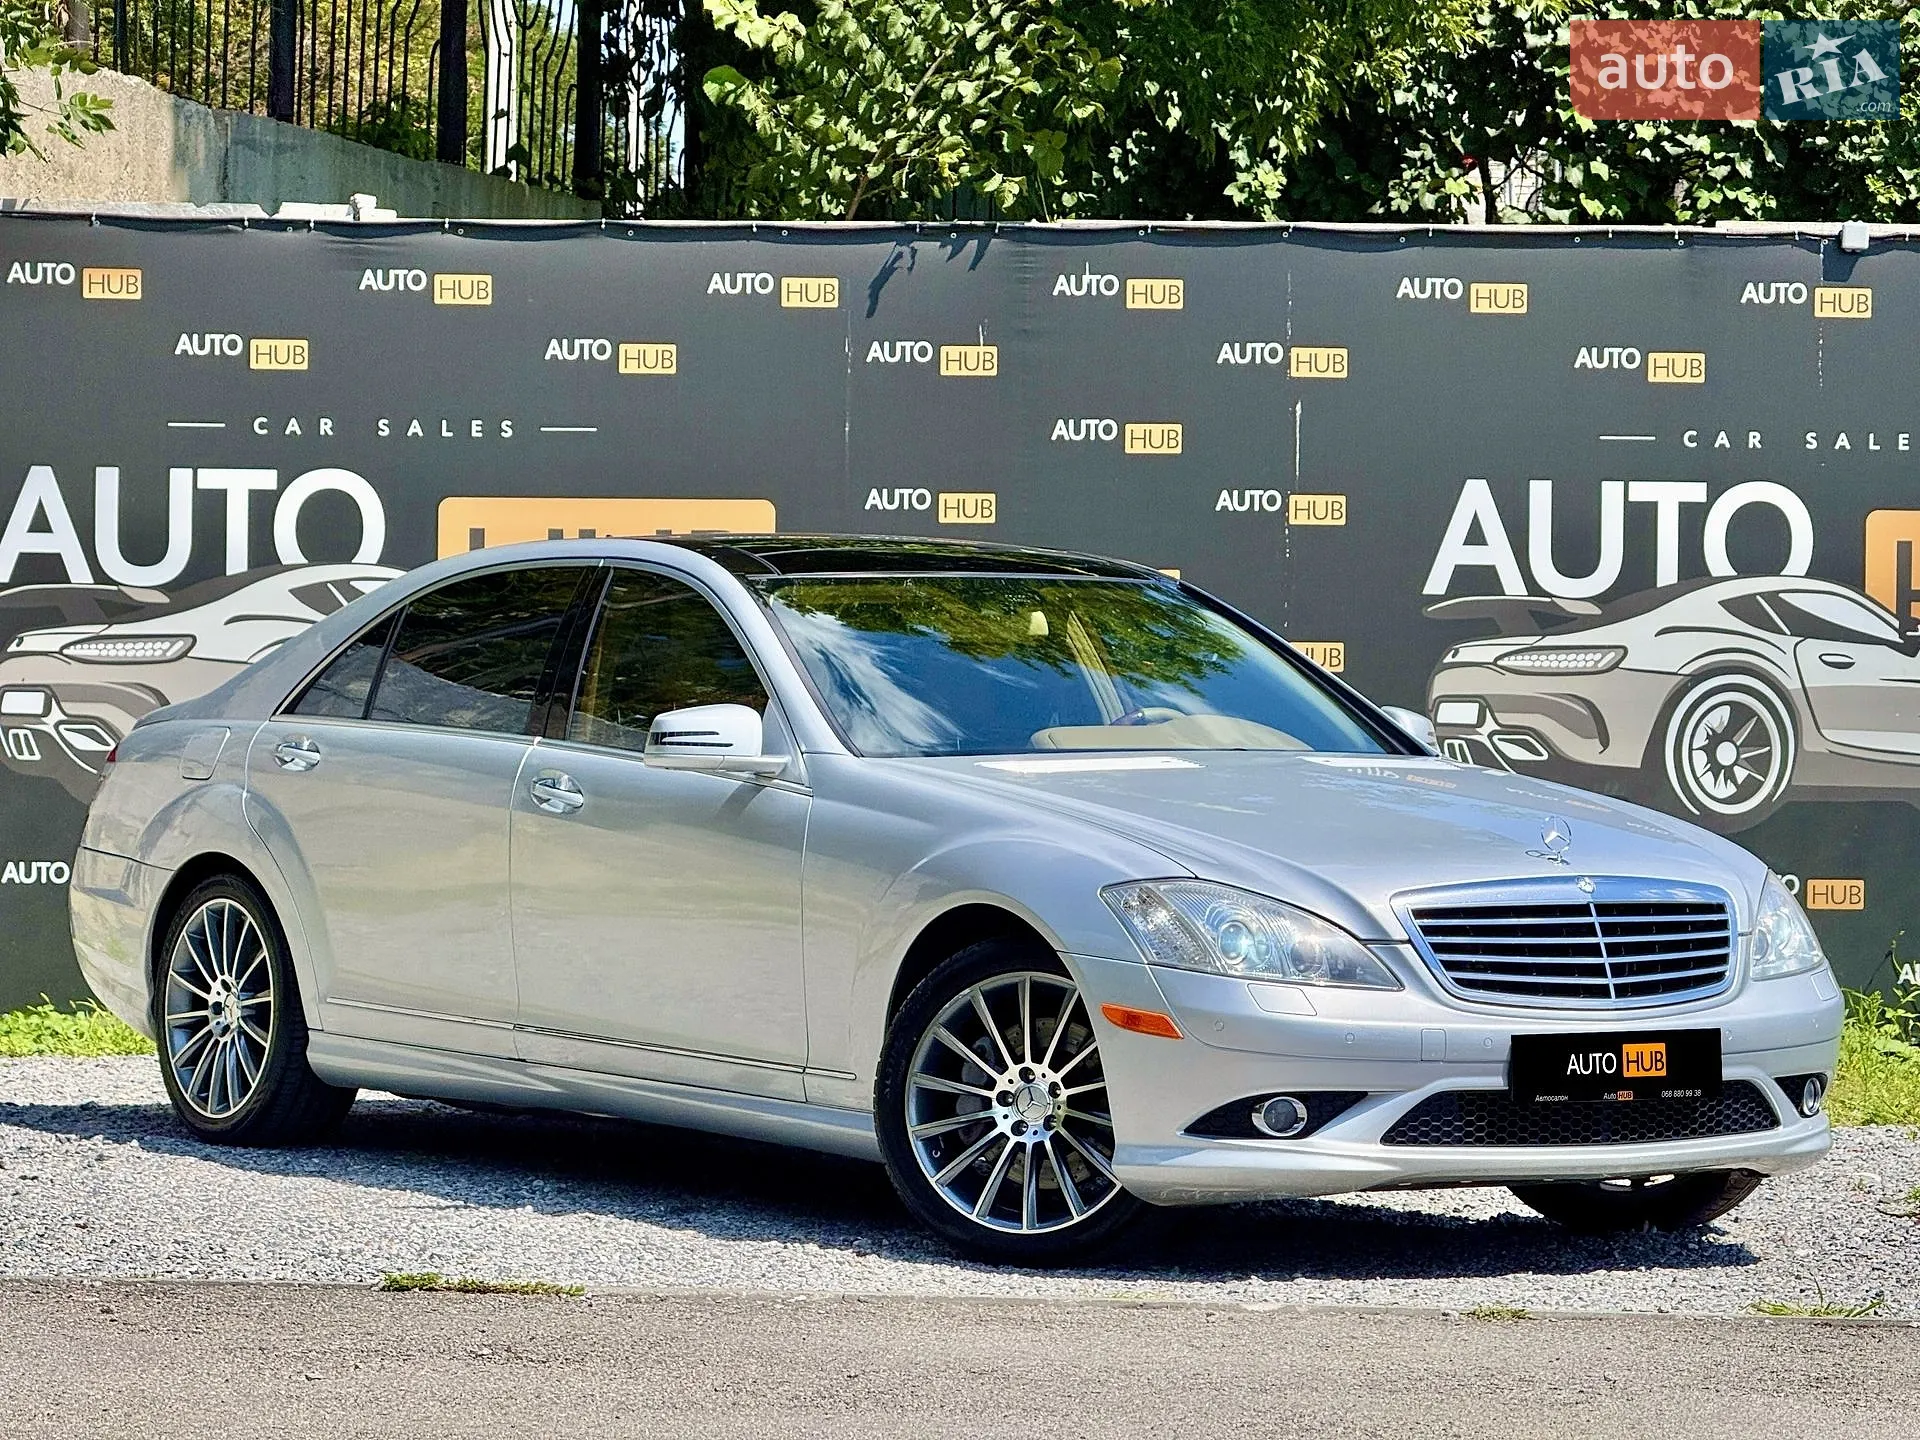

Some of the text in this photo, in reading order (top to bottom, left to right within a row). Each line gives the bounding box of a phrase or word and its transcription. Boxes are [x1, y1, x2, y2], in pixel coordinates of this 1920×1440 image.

[7, 262, 139, 295] AUTO HUB
[359, 269, 489, 300] AUTO HUB
[707, 273, 836, 303] AUTO HUB
[1053, 274, 1180, 305] AUTO HUB
[1396, 277, 1525, 309] AUTO HUB
[1741, 282, 1869, 313] AUTO HUB
[175, 333, 305, 365] AUTO HUB
[545, 338, 673, 370] AUTO HUB
[866, 341, 994, 372] AUTO HUB
[1217, 342, 1344, 373] AUTO HUB
[1574, 347, 1702, 378] AUTO HUB
[253, 416, 513, 438] CAR SALES
[1051, 418, 1179, 449] AUTO HUB
[1683, 430, 1910, 451] CAR SALE
[865, 488, 992, 519] AUTO HUB
[1216, 490, 1343, 521] AUTO HUB
[0, 465, 387, 587] AUTO
[1422, 478, 1814, 598] AUTO
[1305, 647, 1341, 668] UB
[1, 861, 70, 884] AUTO
[1812, 884, 1861, 905] HUB
[1567, 1050, 1664, 1075] AUTO HUB
[1603, 1091, 1633, 1100] Auto HUB
[1661, 1090, 1672, 1098] 068
[1685, 1089, 1692, 1097] 99
[1693, 1089, 1701, 1097] 38
